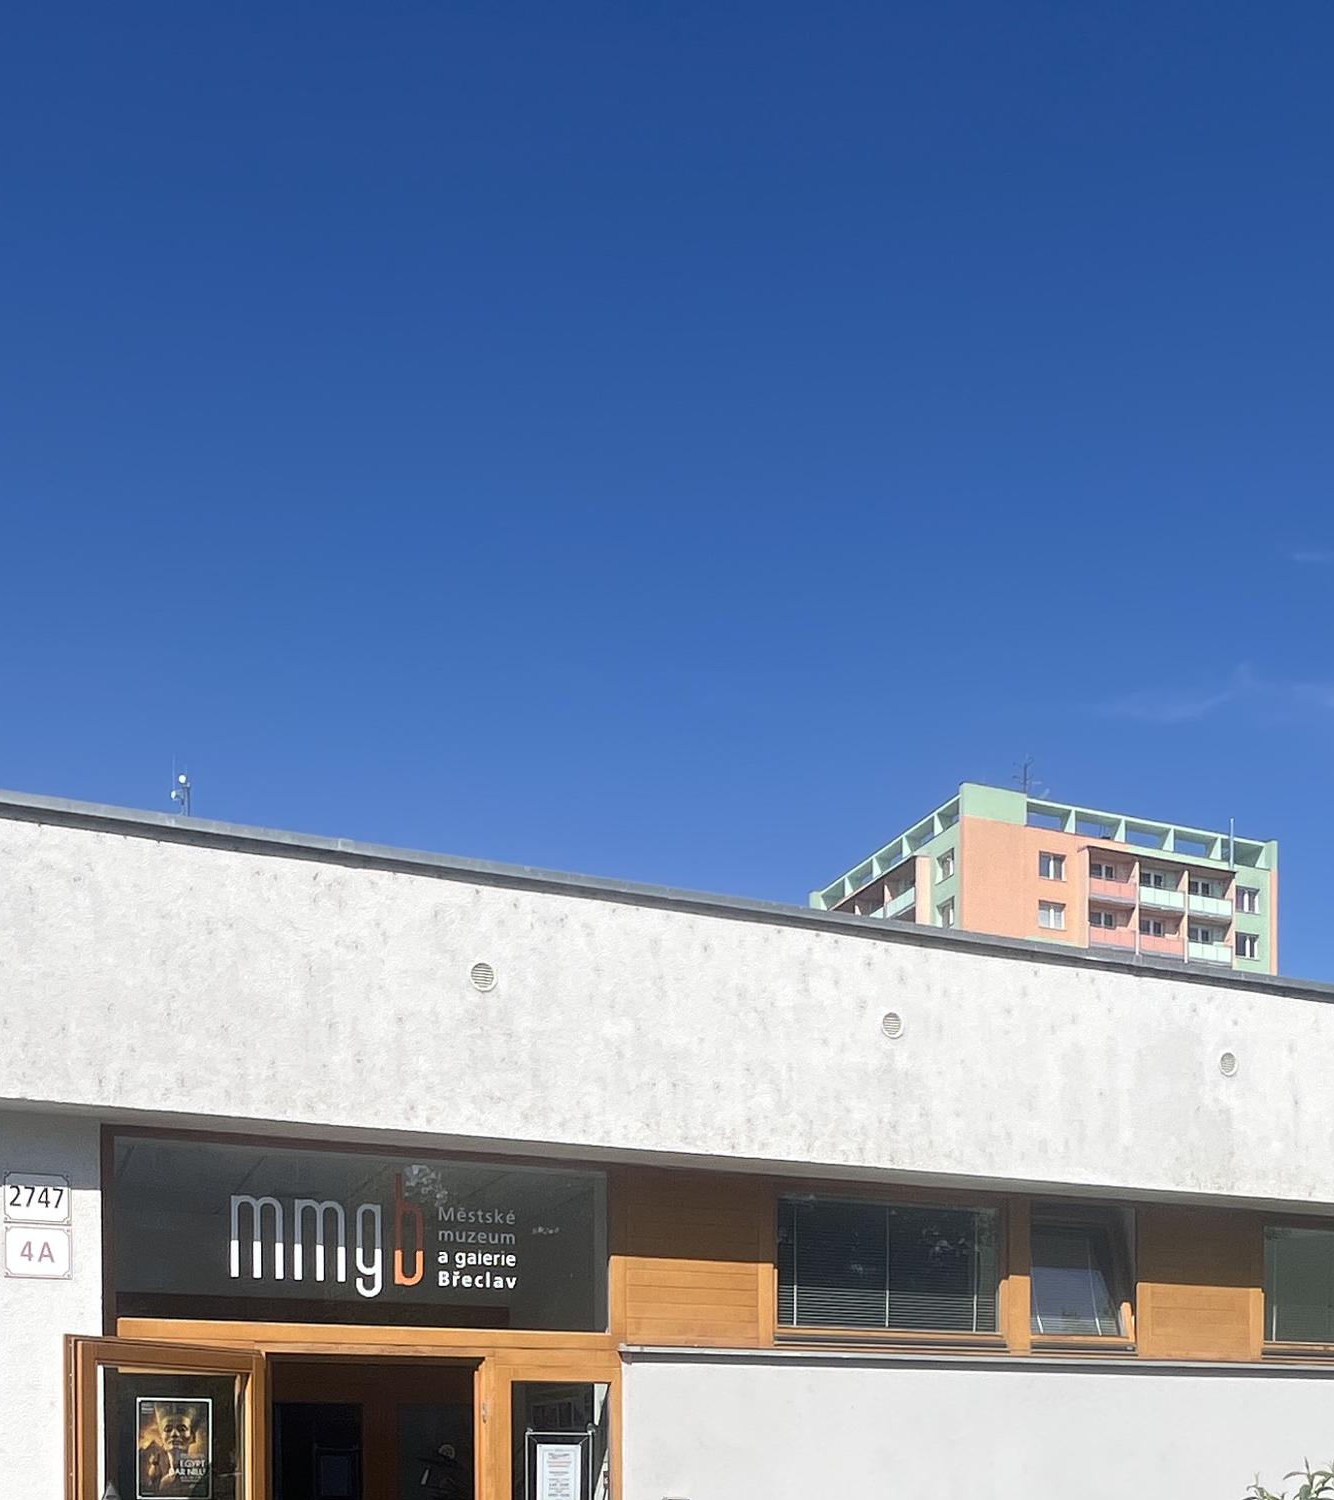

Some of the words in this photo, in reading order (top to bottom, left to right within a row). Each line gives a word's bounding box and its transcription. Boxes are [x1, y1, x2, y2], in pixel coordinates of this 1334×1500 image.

[9, 1185, 66, 1209] 2747
[437, 1206, 516, 1225] Městské
[438, 1229, 516, 1246] muzeum
[437, 1251, 449, 1265] a
[455, 1250, 516, 1269] galerie
[437, 1270, 517, 1290] Břeclav
